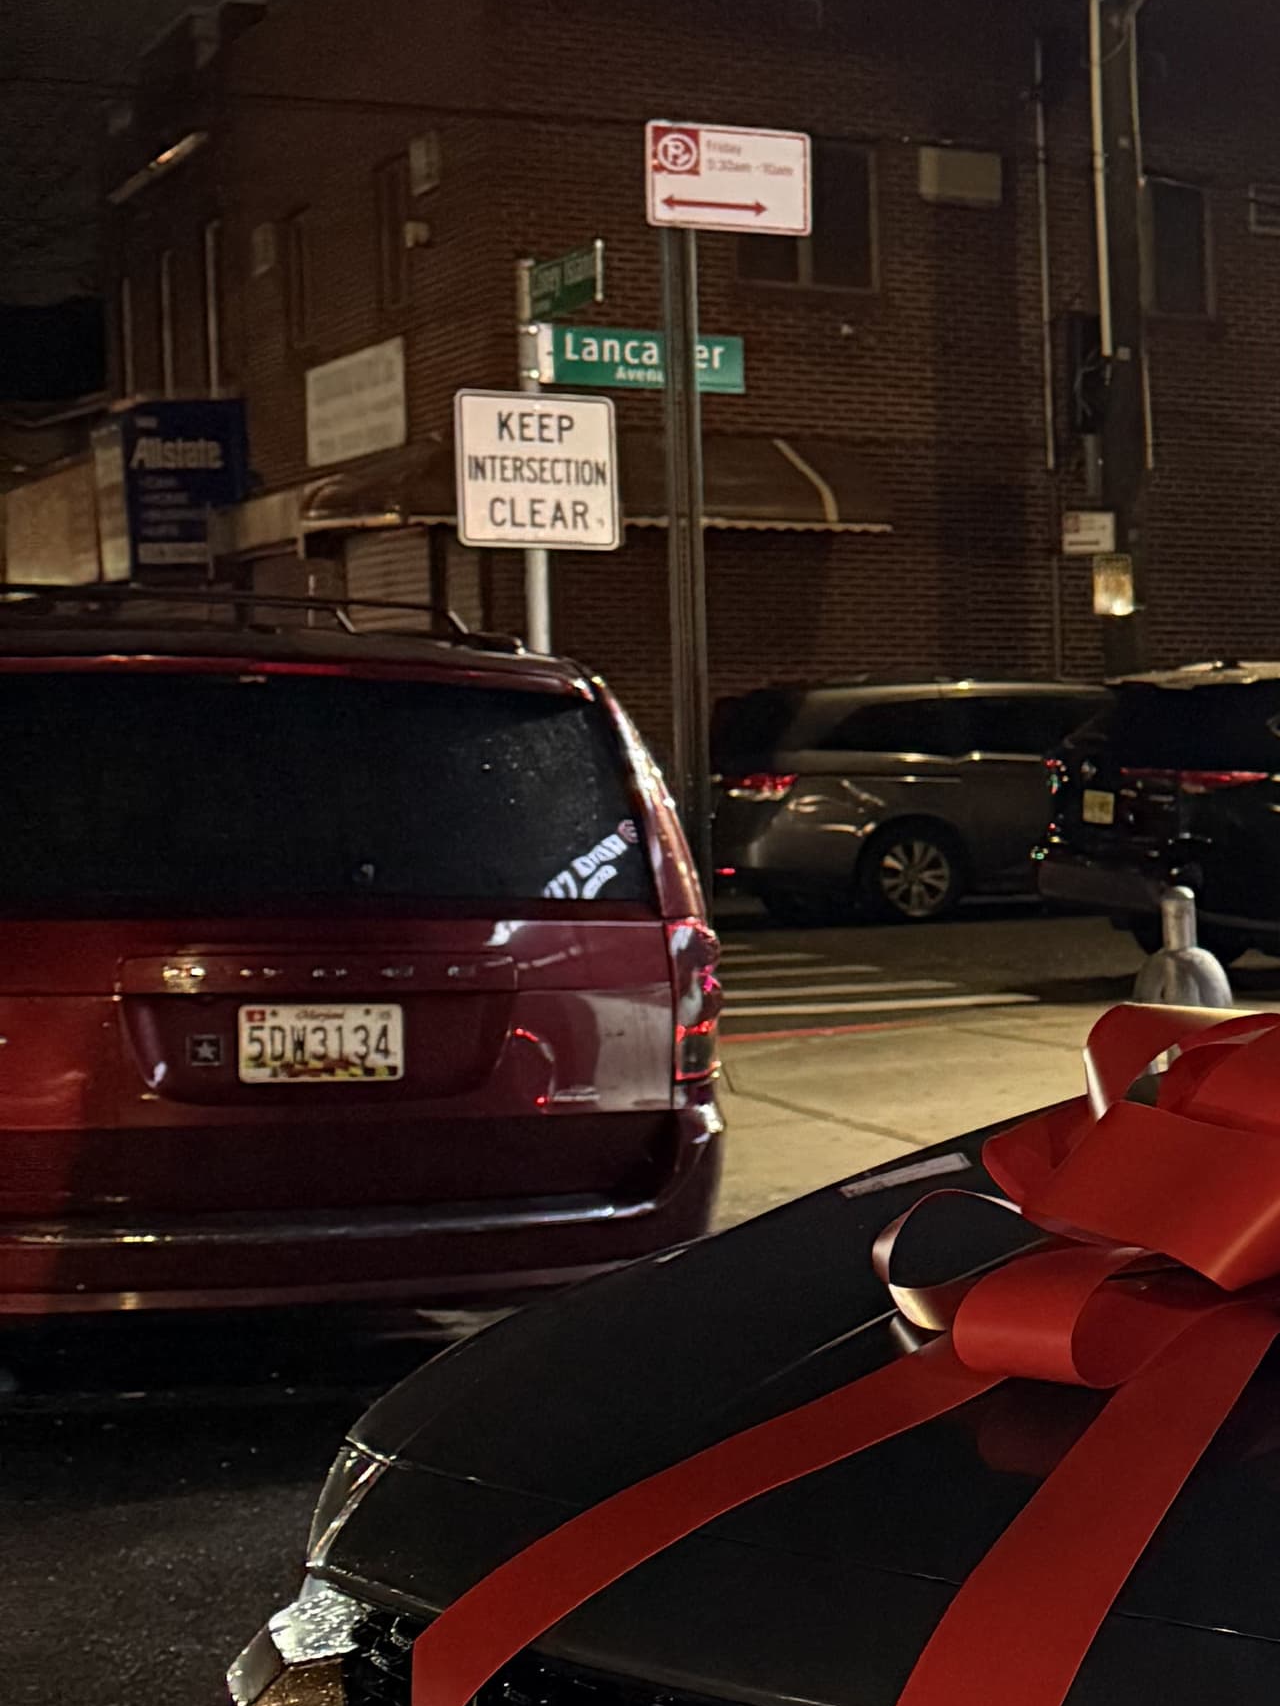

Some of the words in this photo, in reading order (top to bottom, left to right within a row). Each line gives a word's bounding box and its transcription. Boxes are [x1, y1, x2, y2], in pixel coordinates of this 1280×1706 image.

[564, 333, 724, 369] Lancaer
[497, 410, 575, 444] KEEP
[467, 454, 607, 486] INTERSECTION
[489, 497, 590, 530] CLEAR
[247, 1024, 392, 1066] 5DW3134
